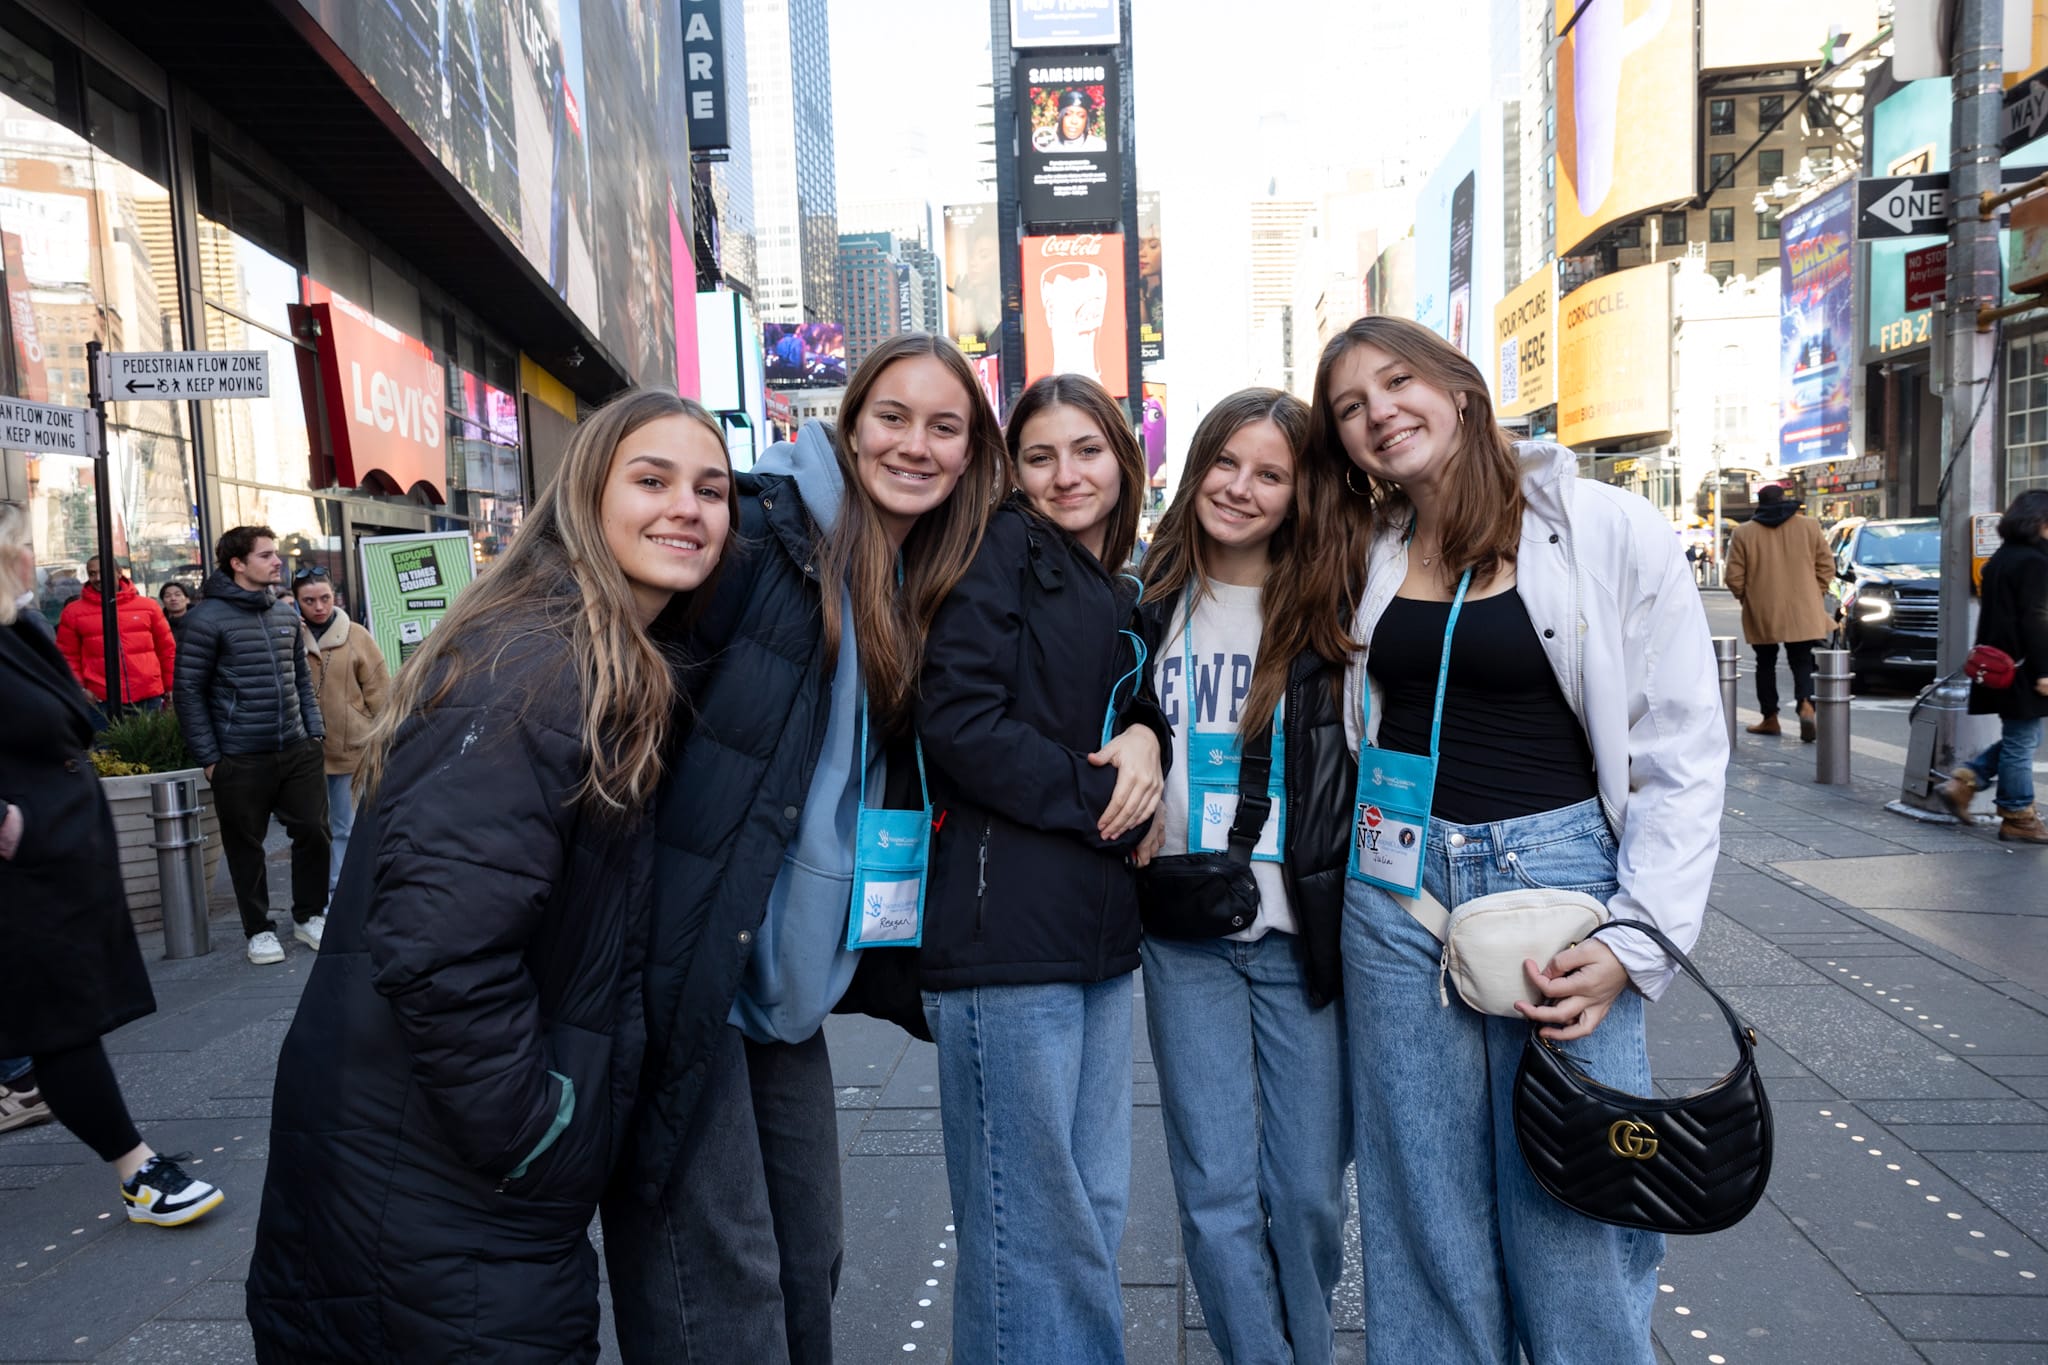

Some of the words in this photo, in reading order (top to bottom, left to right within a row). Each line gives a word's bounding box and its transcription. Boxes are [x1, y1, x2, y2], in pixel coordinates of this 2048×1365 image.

[685, 0, 714, 119] ARE
[1028, 66, 1105, 83] SAMSUNG
[2011, 90, 2046, 130] WAY
[1888, 192, 1943, 218] ONE
[1909, 255, 1922, 268] NO
[1499, 311, 1516, 339] YOUR
[1518, 290, 1546, 330] PICTURE
[1880, 319, 1913, 353] FEB
[1519, 331, 1546, 376] HERE
[123, 358, 194, 374] PEDESTRIAN
[198, 357, 227, 373] FLOW
[233, 357, 262, 371] ZONE
[187, 378, 215, 392] KEEP
[220, 377, 263, 392] MOVING
[16, 407, 43, 424] FLOW
[46, 411, 74, 428] ZONE
[6, 426, 30, 443] KEEP
[35, 430, 76, 449] MOVING
[393, 548, 433, 562] EXPLORE
[396, 561, 422, 571] MORE
[398, 571, 409, 583] IN
[409, 566, 436, 581] TIMES
[401, 576, 437, 592] SQUARE
[424, 600, 444, 608] STREET
[1153, 653, 1252, 727] EWP
[1358, 804, 1367, 825] I
[1357, 828, 1381, 851] NY
[879, 917, 911, 930] Reagan
